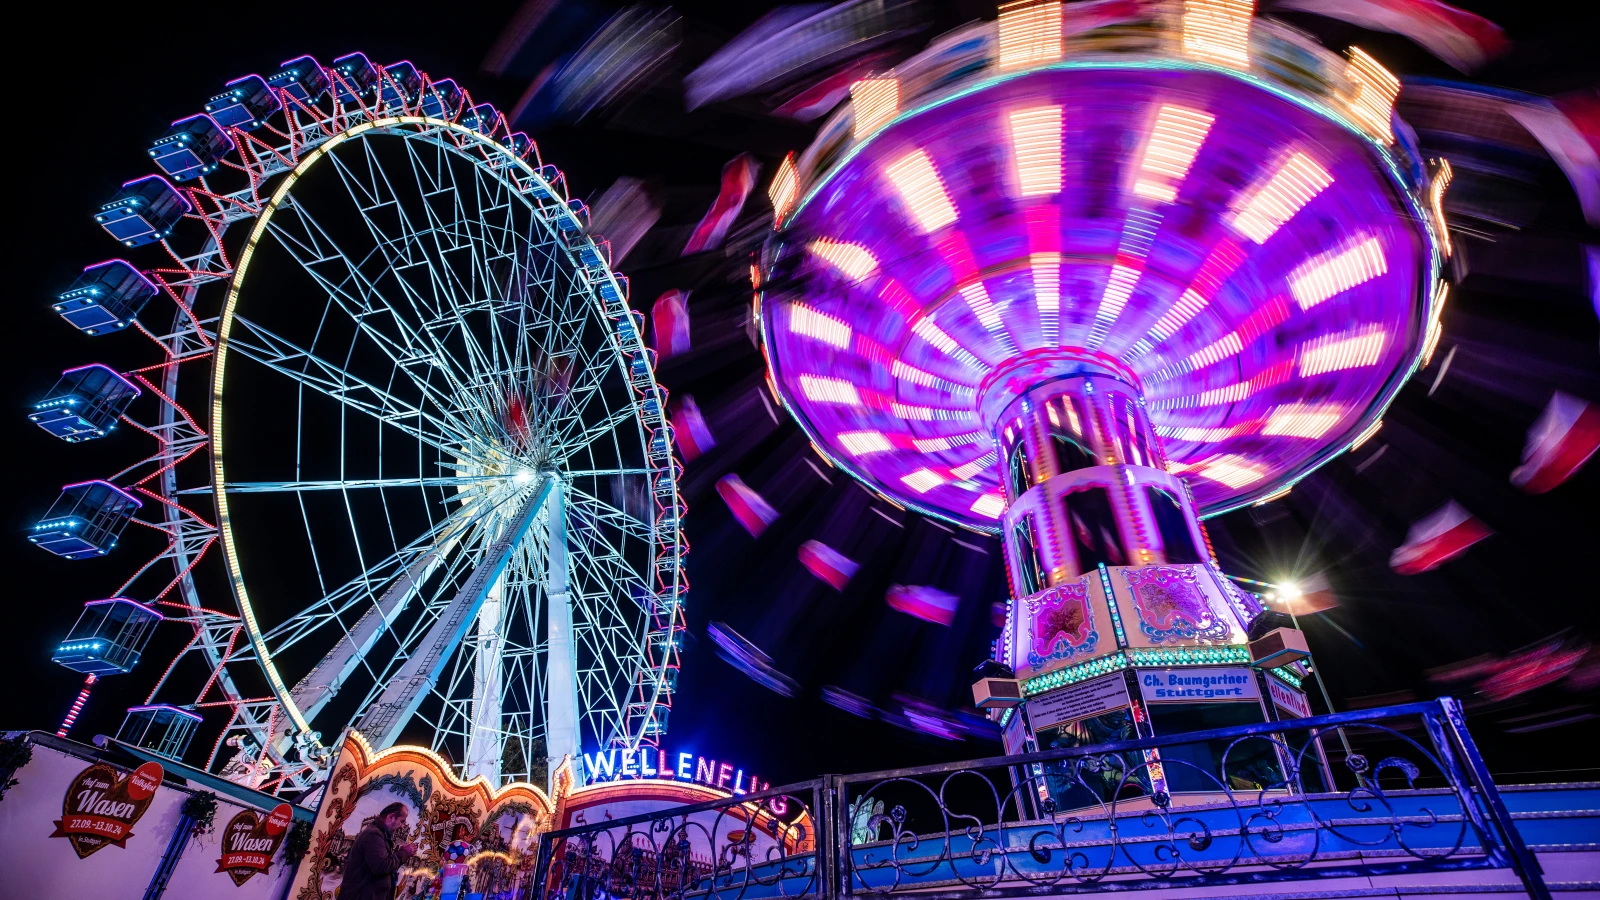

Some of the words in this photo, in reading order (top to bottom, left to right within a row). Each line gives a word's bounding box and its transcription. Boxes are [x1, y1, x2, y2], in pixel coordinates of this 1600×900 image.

[1143, 674, 1164, 687] Ch.
[1168, 674, 1249, 688] Baumgartner
[1155, 687, 1243, 698] Stuttgart
[82, 777, 97, 788] Auf
[95, 781, 110, 789] zum
[131, 775, 157, 792] Volksfest
[76, 789, 135, 819] Wasen
[230, 832, 274, 852] Wasen
